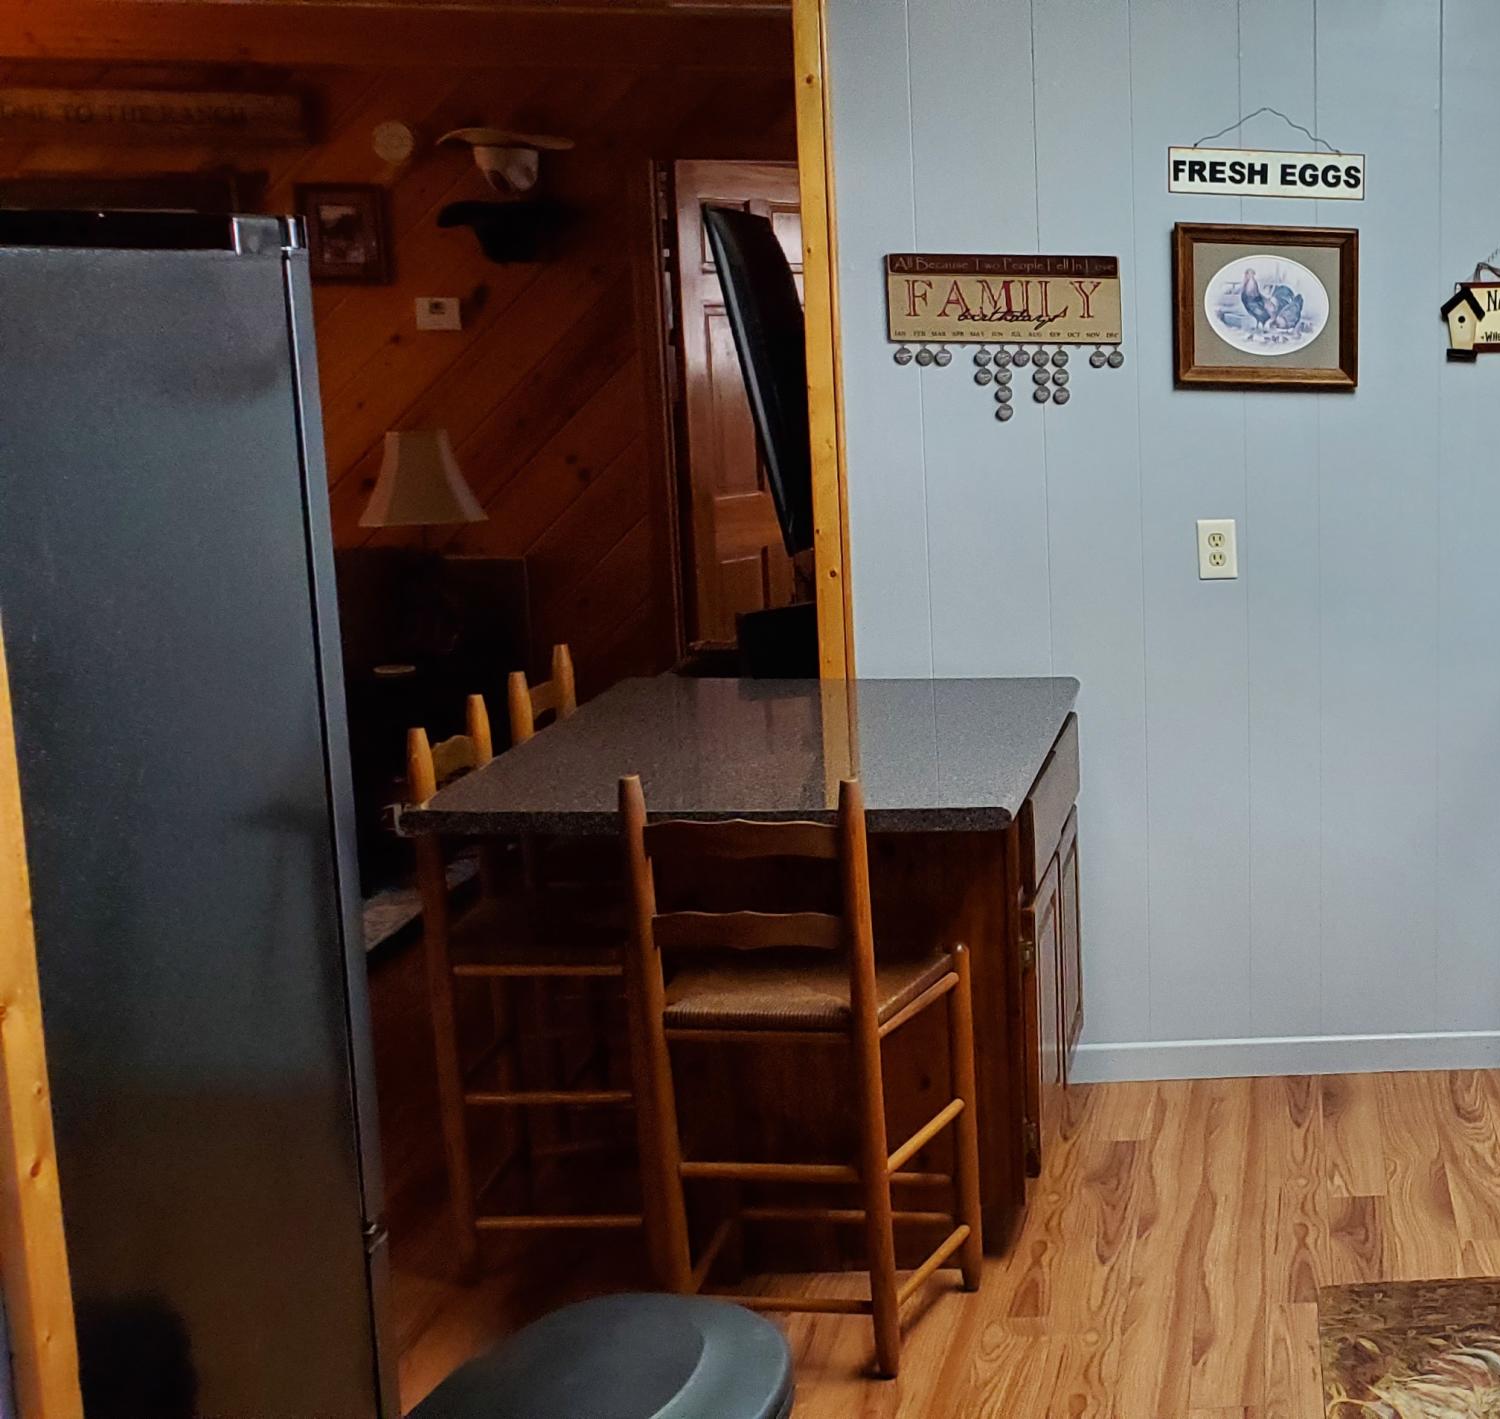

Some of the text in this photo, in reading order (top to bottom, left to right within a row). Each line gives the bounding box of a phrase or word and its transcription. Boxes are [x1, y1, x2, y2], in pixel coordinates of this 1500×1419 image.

[1172, 159, 1361, 189] FRESH EGGS
[895, 256, 912, 270] All
[915, 257, 969, 271] Because
[975, 258, 1000, 271] Two
[1002, 258, 1044, 274] People
[1046, 259, 1069, 272] Fell
[1085, 260, 1115, 272] Love
[905, 279, 1102, 319] FAMILY
[957, 306, 1069, 330] birthdays
